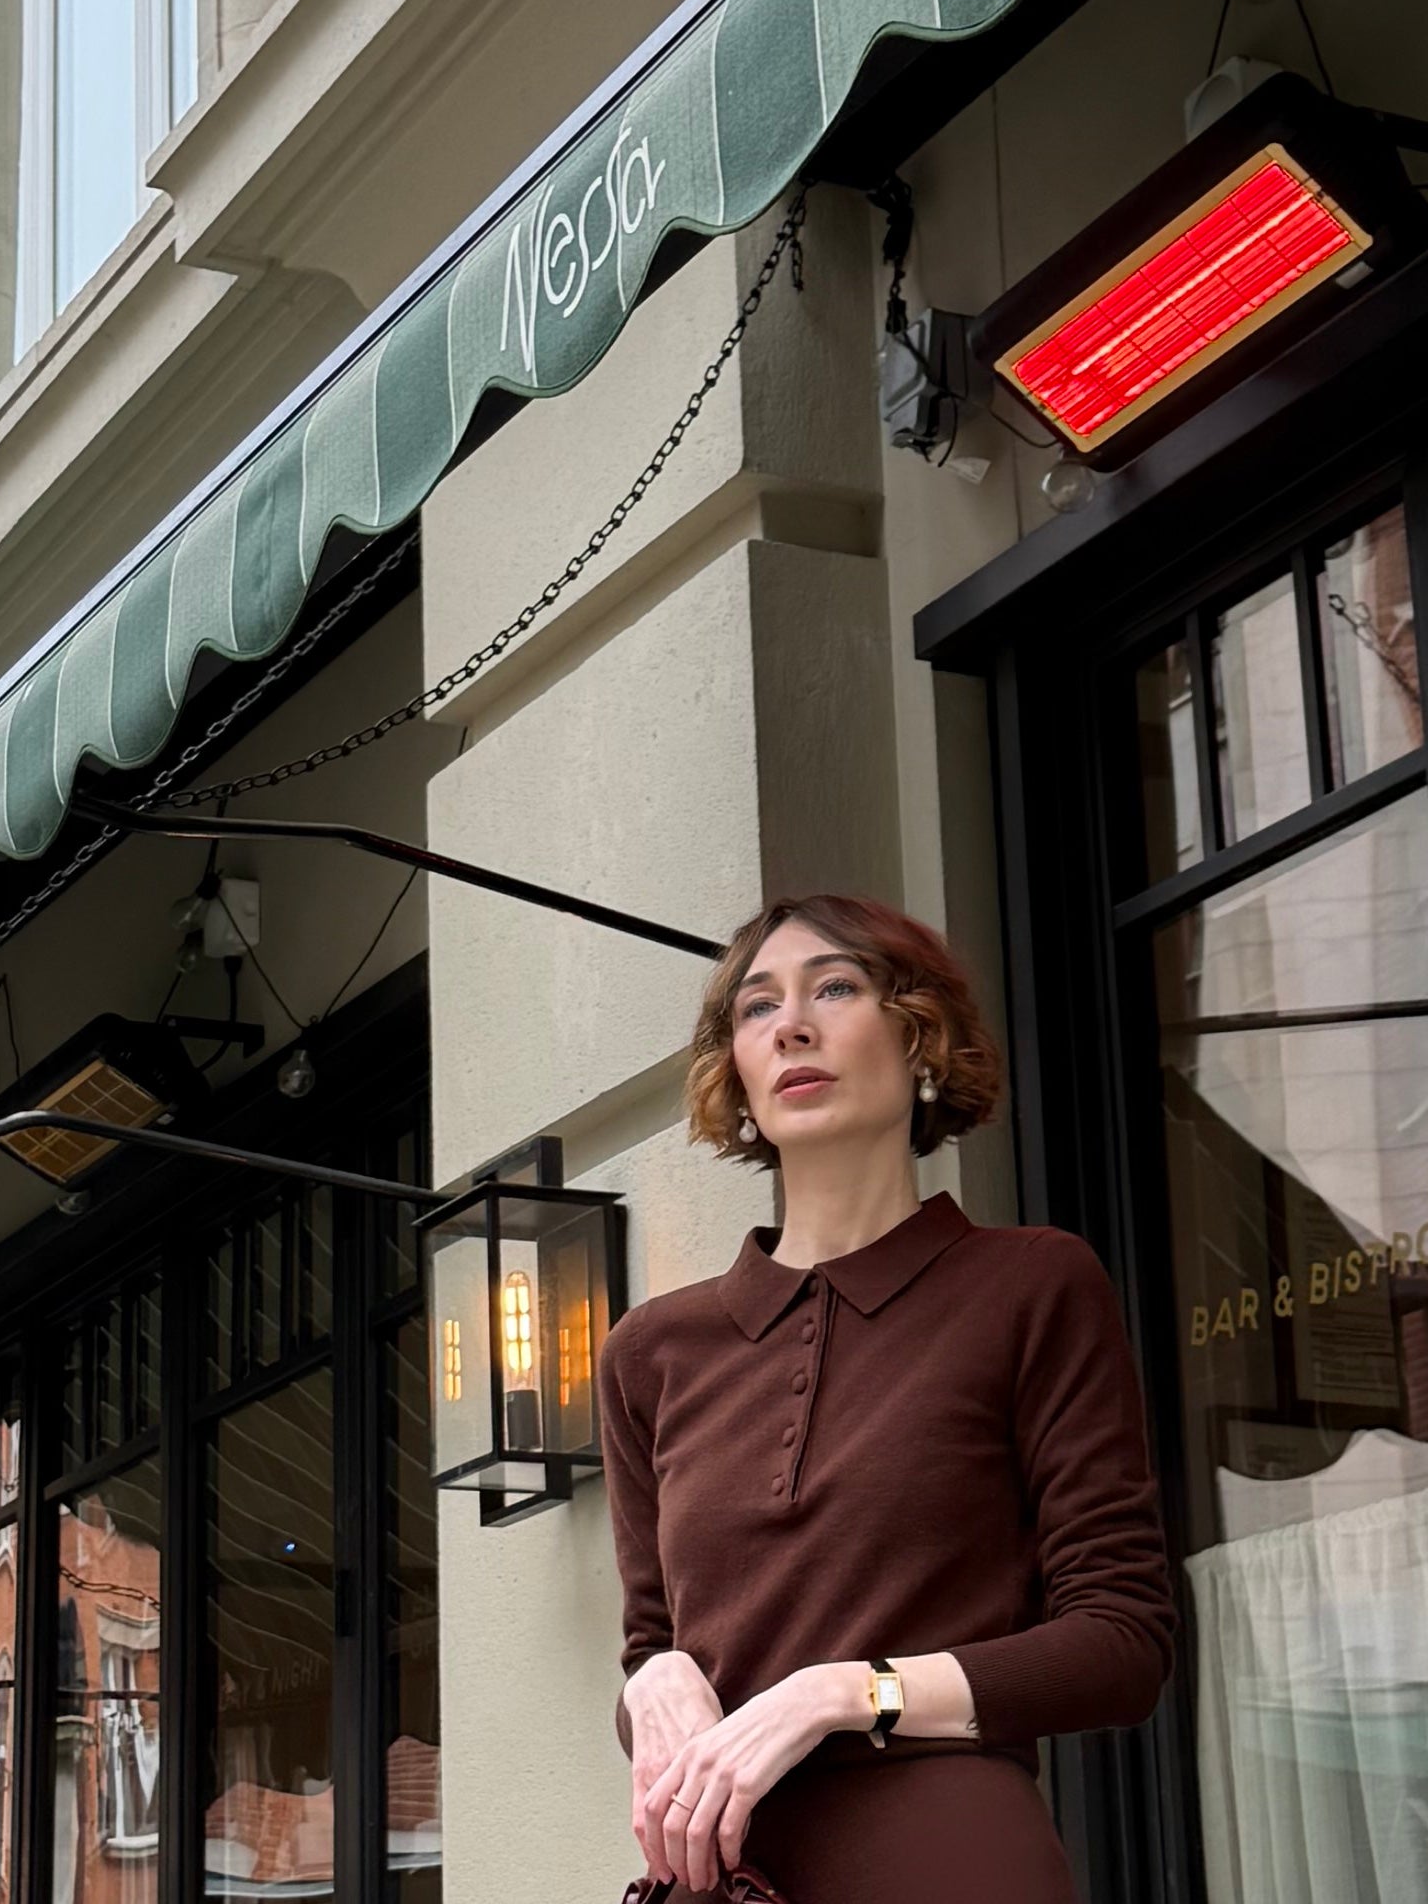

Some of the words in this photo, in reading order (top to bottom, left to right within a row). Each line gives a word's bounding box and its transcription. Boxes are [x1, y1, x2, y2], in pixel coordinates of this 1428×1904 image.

[500, 127, 666, 372] Nessa
[1190, 1288, 1259, 1346] BAR
[1274, 1275, 1294, 1318] &
